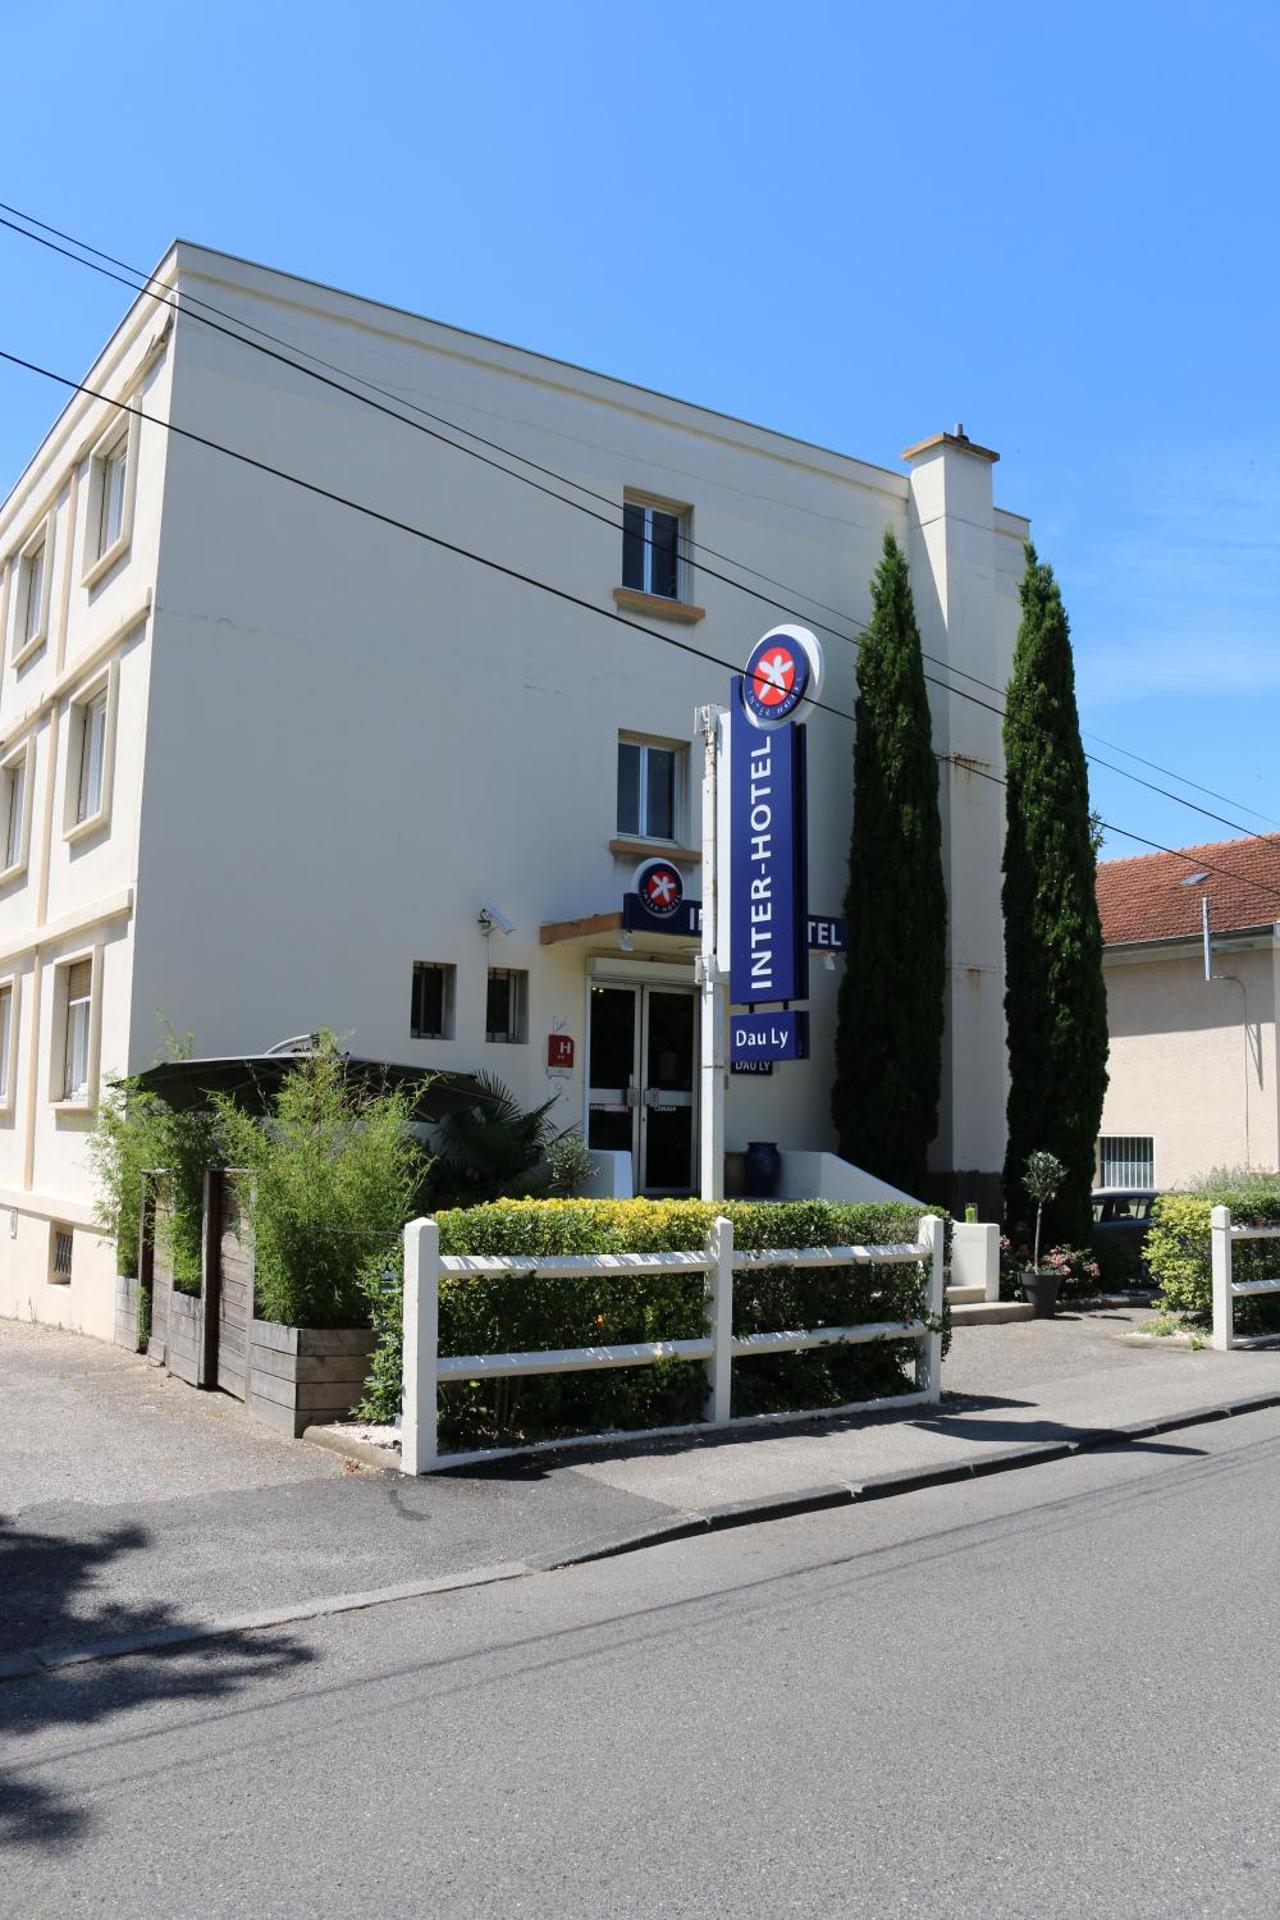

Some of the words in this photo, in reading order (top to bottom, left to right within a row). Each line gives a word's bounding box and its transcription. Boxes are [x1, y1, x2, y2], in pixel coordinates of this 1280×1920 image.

[751, 737, 772, 989] INTER-HOTEL
[736, 1029, 766, 1047] Dau
[771, 1027, 788, 1049] Ly
[560, 1041, 571, 1054] H
[735, 1060, 757, 1071] DAU
